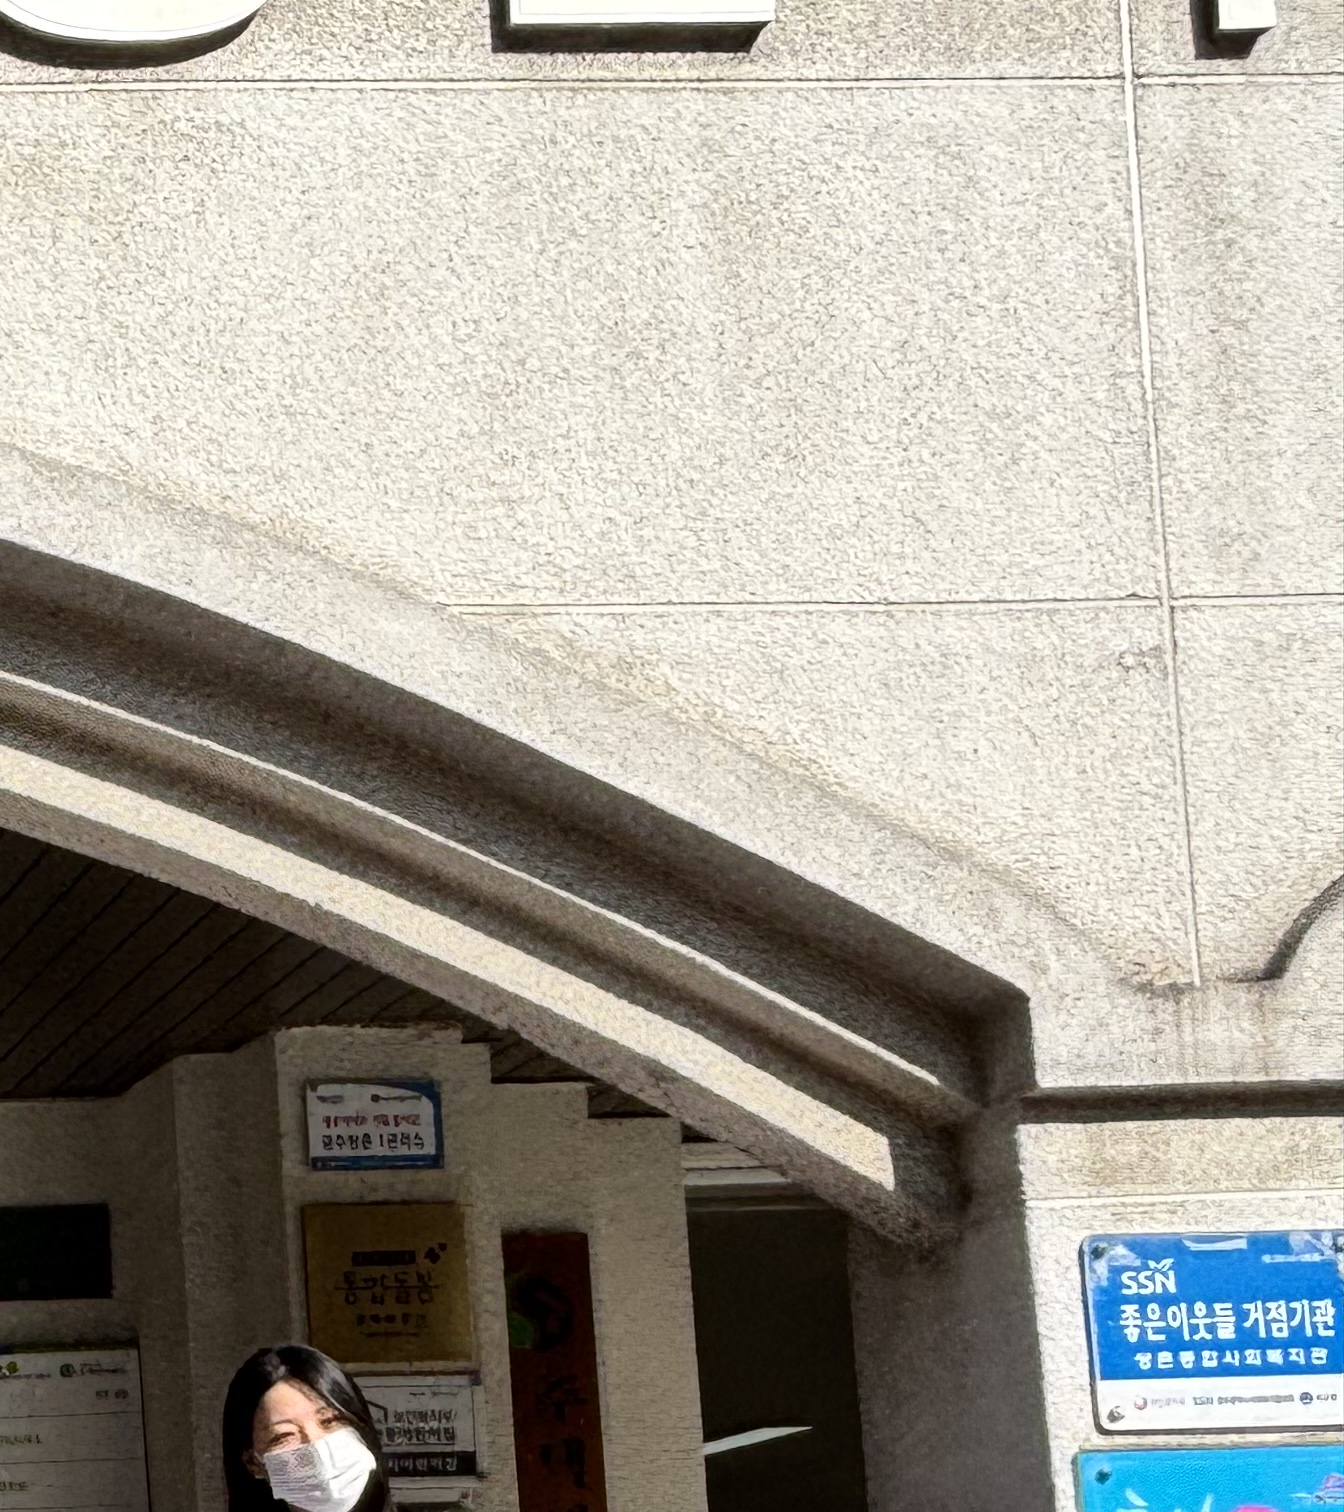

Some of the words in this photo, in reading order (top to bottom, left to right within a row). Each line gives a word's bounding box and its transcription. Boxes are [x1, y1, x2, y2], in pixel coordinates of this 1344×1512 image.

[1121, 1268, 1177, 1296] SSN
[1119, 1301, 1237, 1343] 좋은이웃들
[1241, 1298, 1337, 1339] 거점기관
